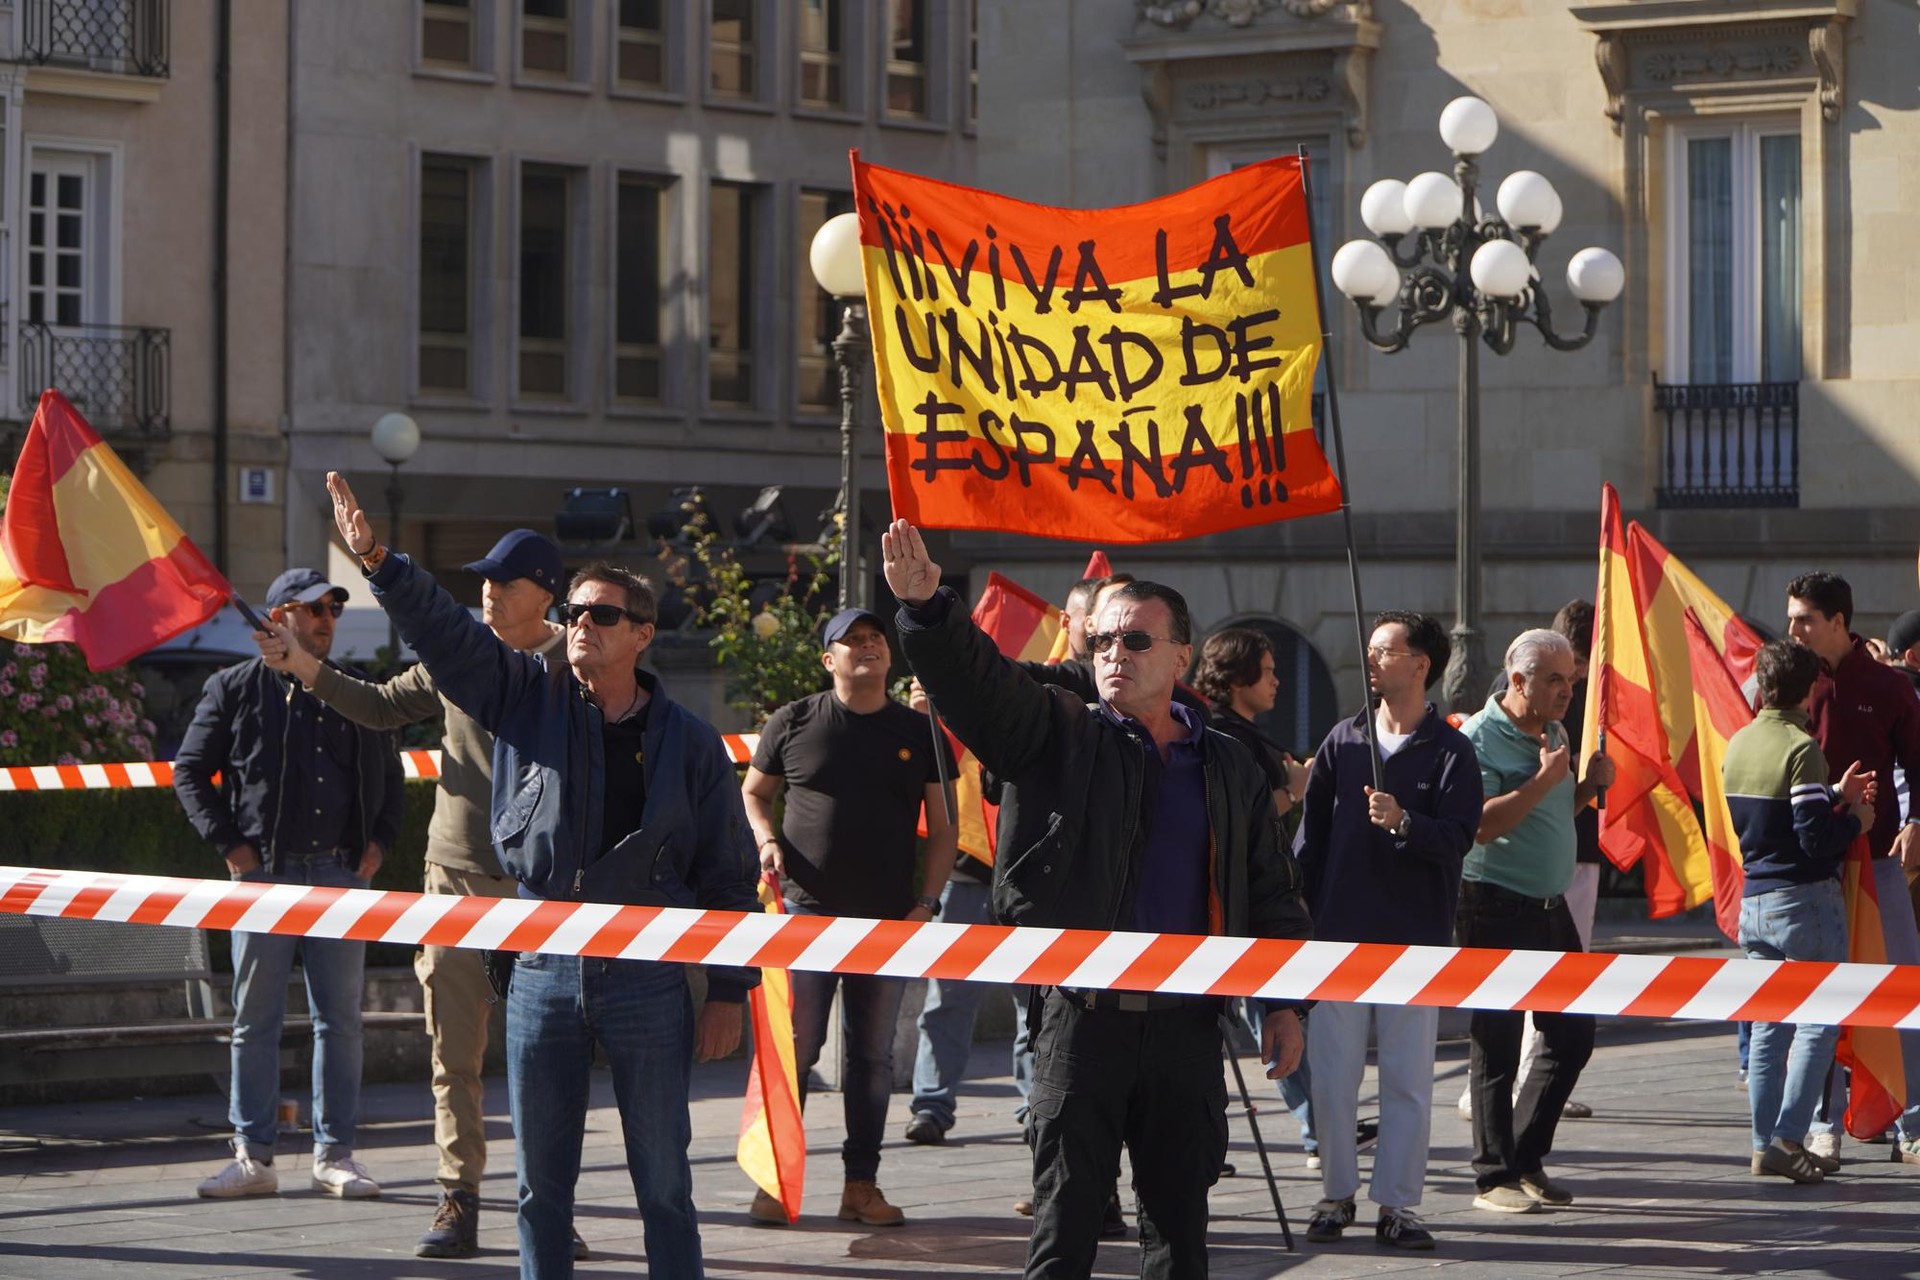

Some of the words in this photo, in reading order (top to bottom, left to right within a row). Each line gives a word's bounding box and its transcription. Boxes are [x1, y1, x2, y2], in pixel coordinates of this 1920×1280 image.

[1152, 213, 1255, 308] LA
[1180, 309, 1281, 386] DE
[911, 382, 1288, 509] ESPAÑA!!!
